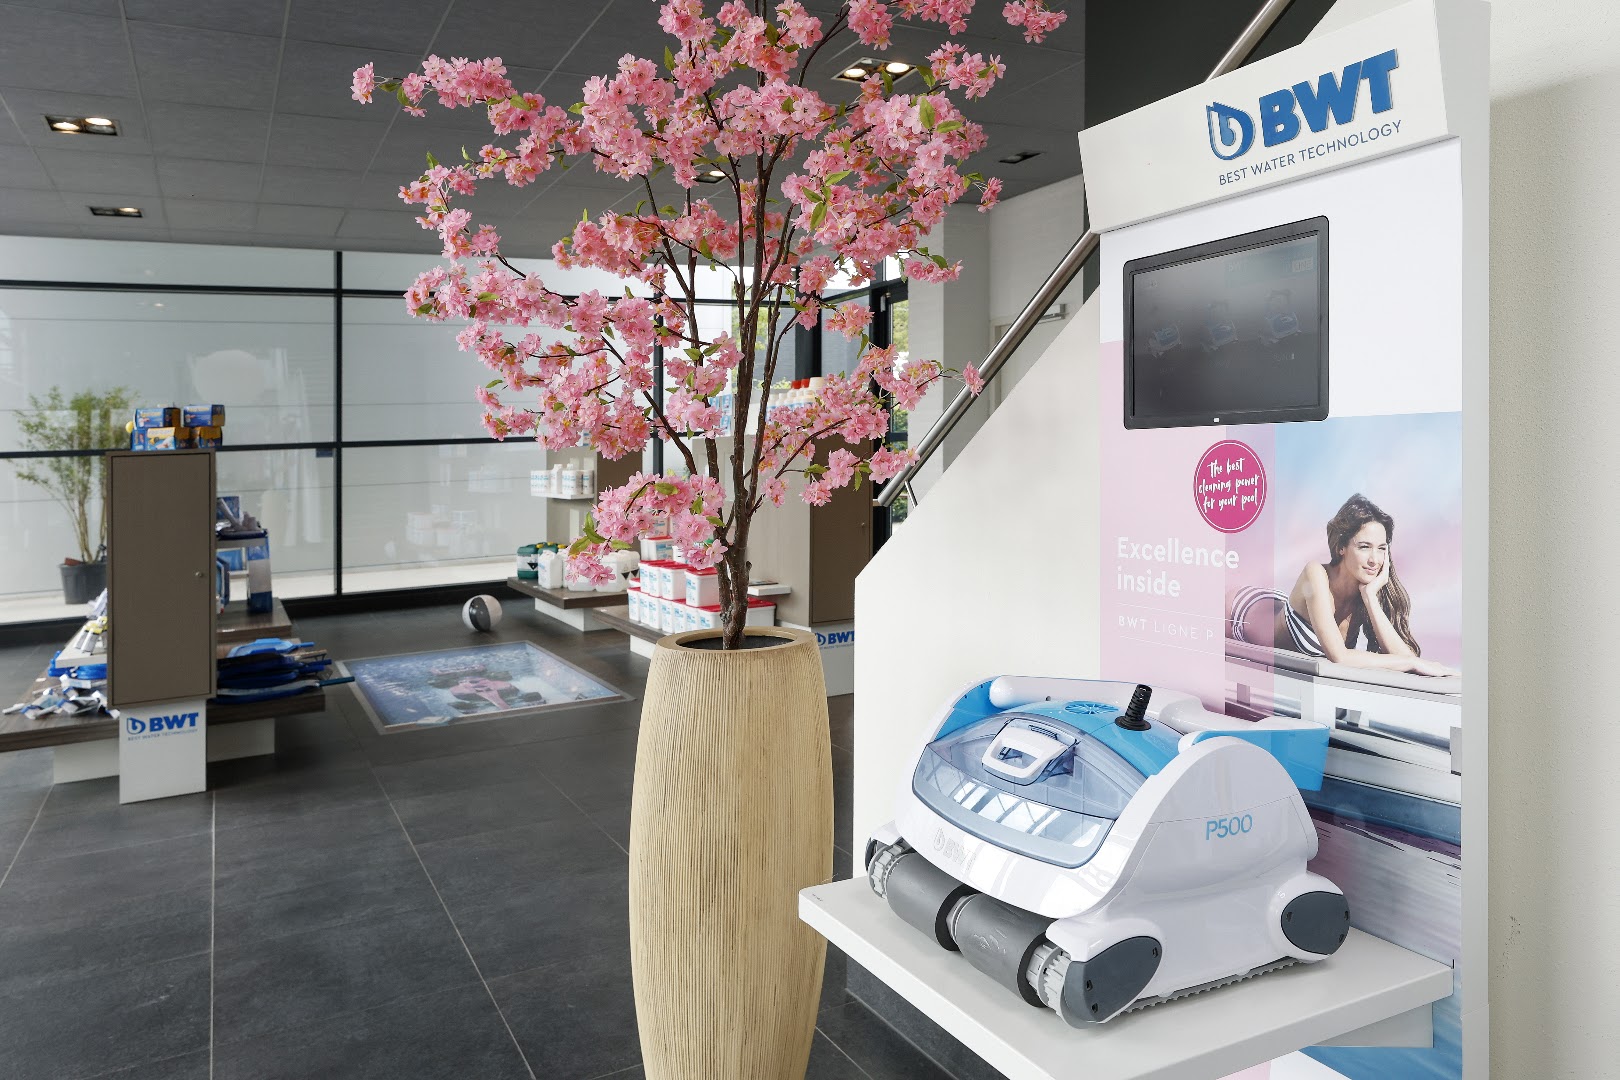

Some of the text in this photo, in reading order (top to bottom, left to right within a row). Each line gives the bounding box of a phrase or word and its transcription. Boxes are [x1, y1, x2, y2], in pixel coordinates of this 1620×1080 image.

[1259, 48, 1399, 148] BWT
[1219, 119, 1402, 186] BEST WATER TECHNOLOGY
[1207, 458, 1245, 478] The best
[1199, 474, 1260, 496] cleaning power
[1203, 488, 1258, 513] for your pool
[1117, 537, 1240, 569] Excellence
[1117, 566, 1181, 597] inside
[1118, 616, 1215, 641] BWT LIGNE P
[149, 712, 199, 732] BWT
[1205, 814, 1253, 841] P500
